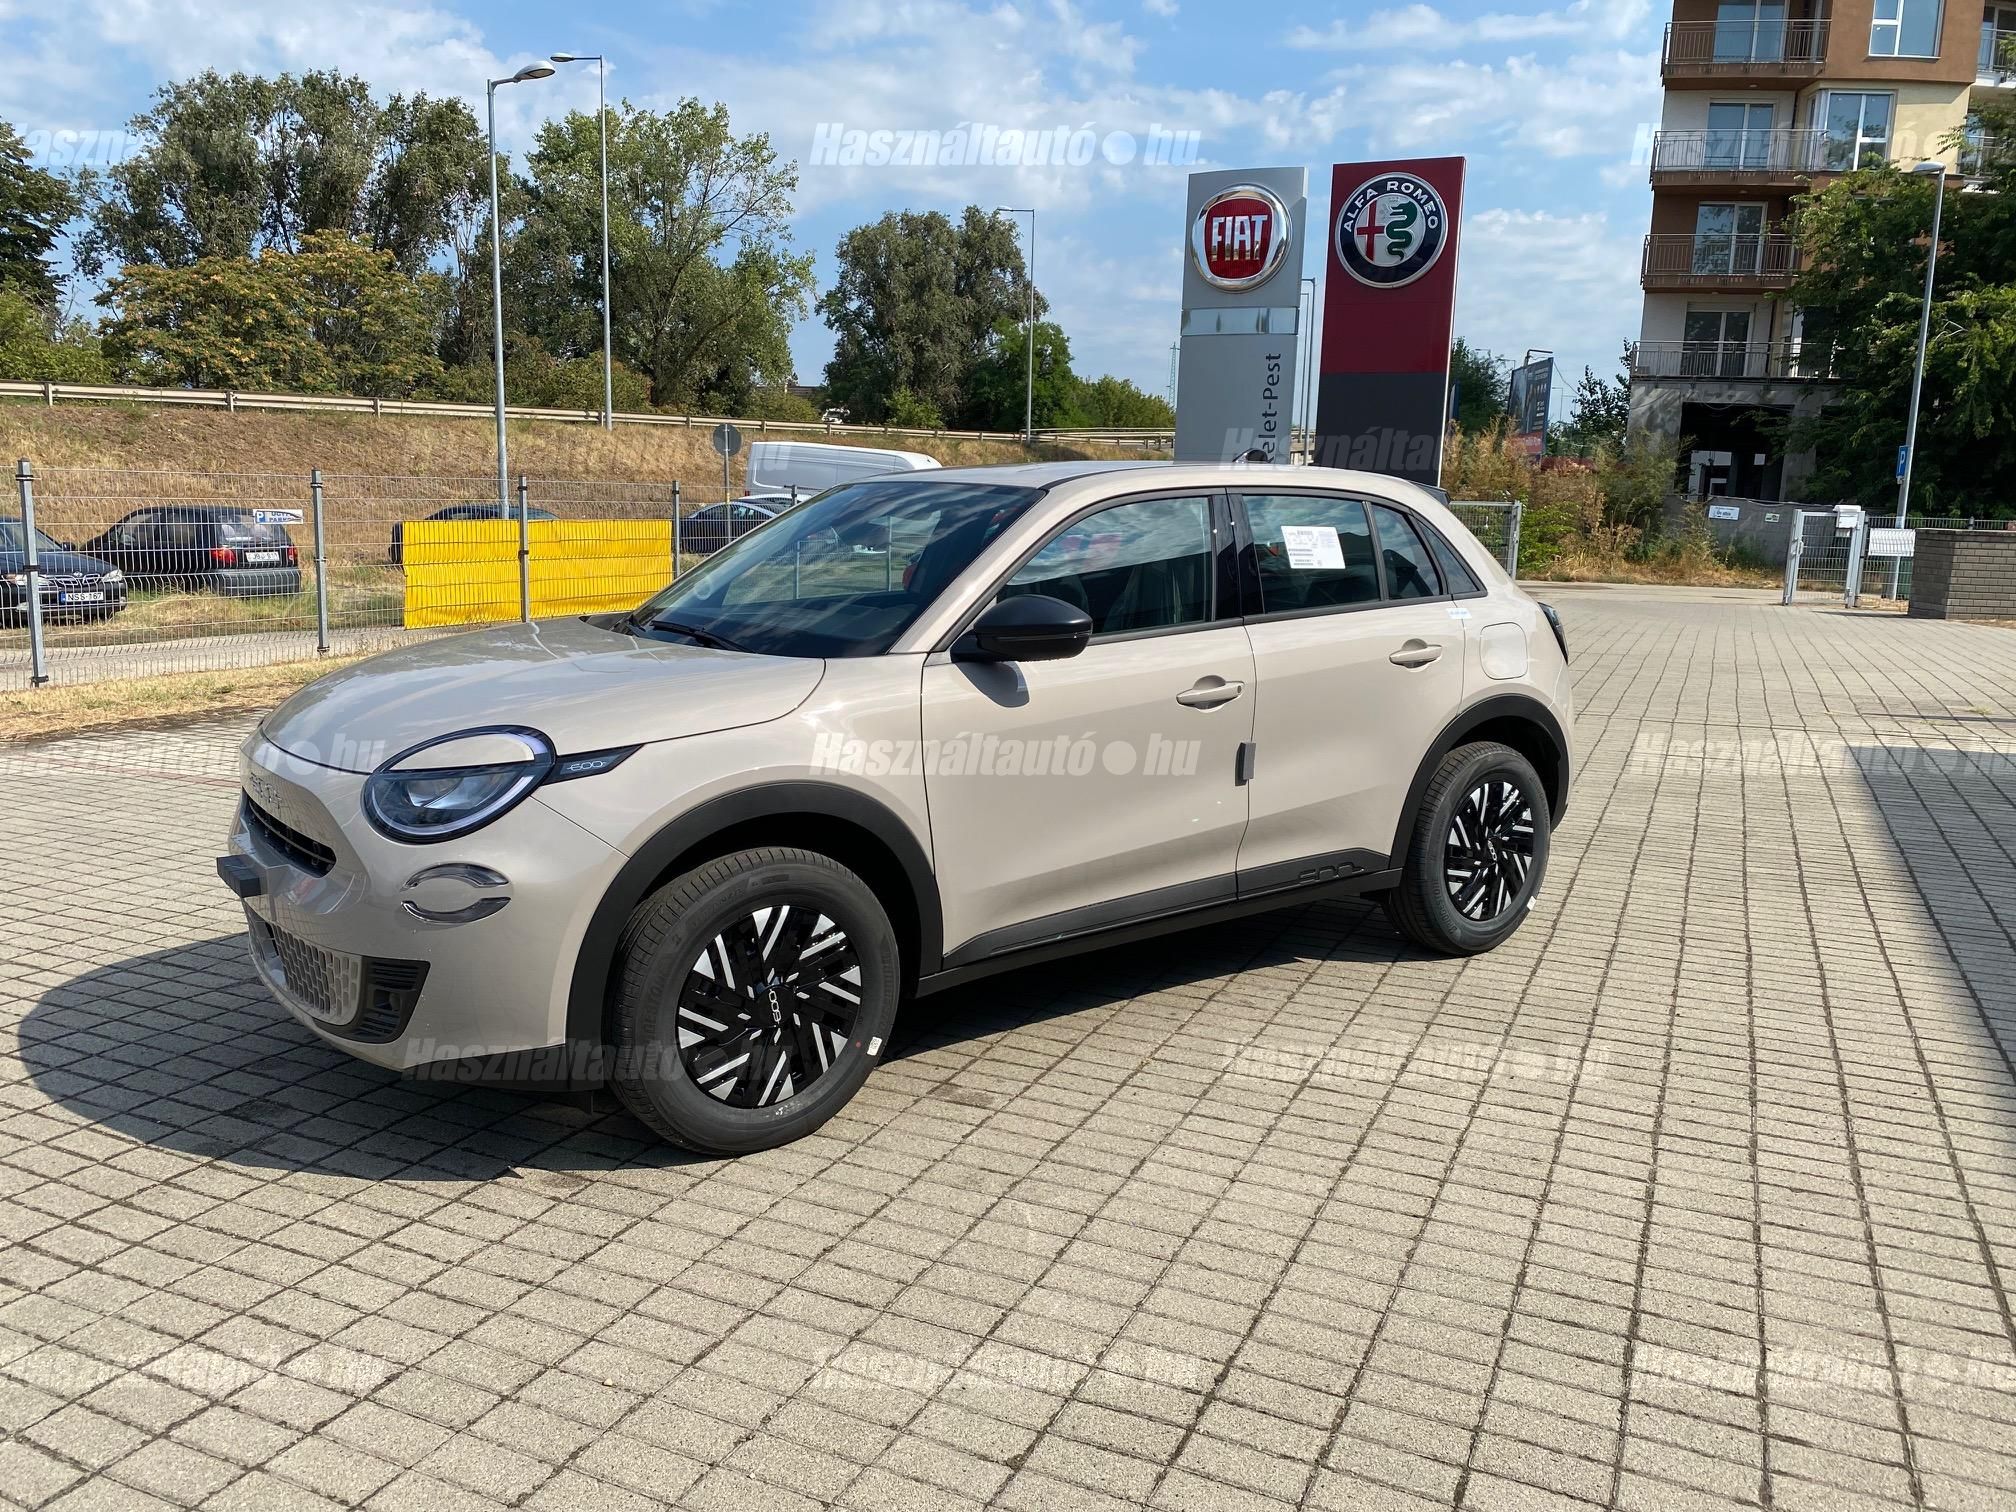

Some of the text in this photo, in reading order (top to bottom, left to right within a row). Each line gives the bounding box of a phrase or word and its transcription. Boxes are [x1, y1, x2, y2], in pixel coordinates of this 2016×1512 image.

[1344, 180, 1439, 233] ALFA ROMEO
[1211, 214, 1268, 262] FIAT
